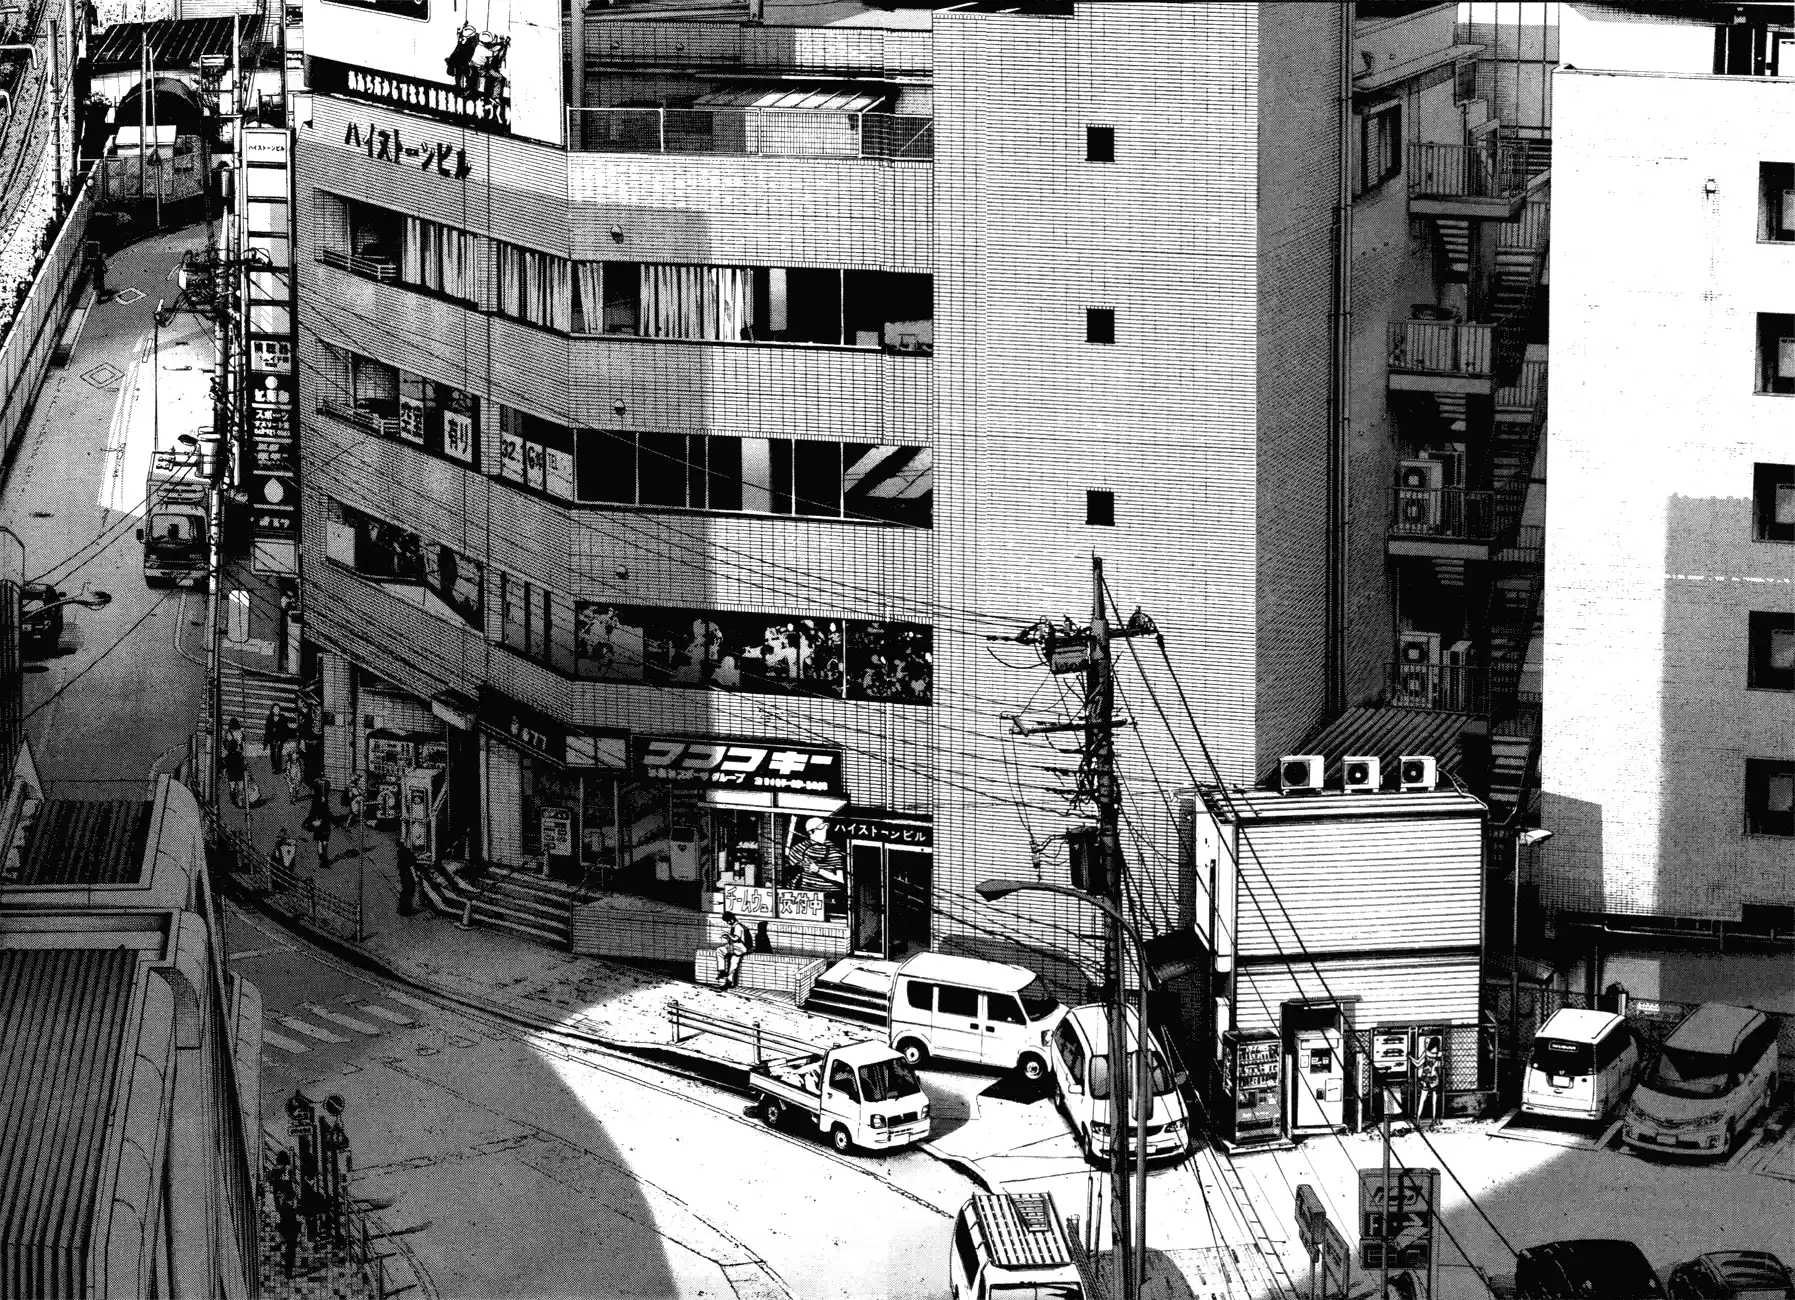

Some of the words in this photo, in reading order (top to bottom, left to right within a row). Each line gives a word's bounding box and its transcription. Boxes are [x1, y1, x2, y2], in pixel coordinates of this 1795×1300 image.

[344, 121, 472, 180] ハイストーンビル
[834, 823, 926, 842] ハイストーンビル
[780, 891, 823, 916] 受付中
